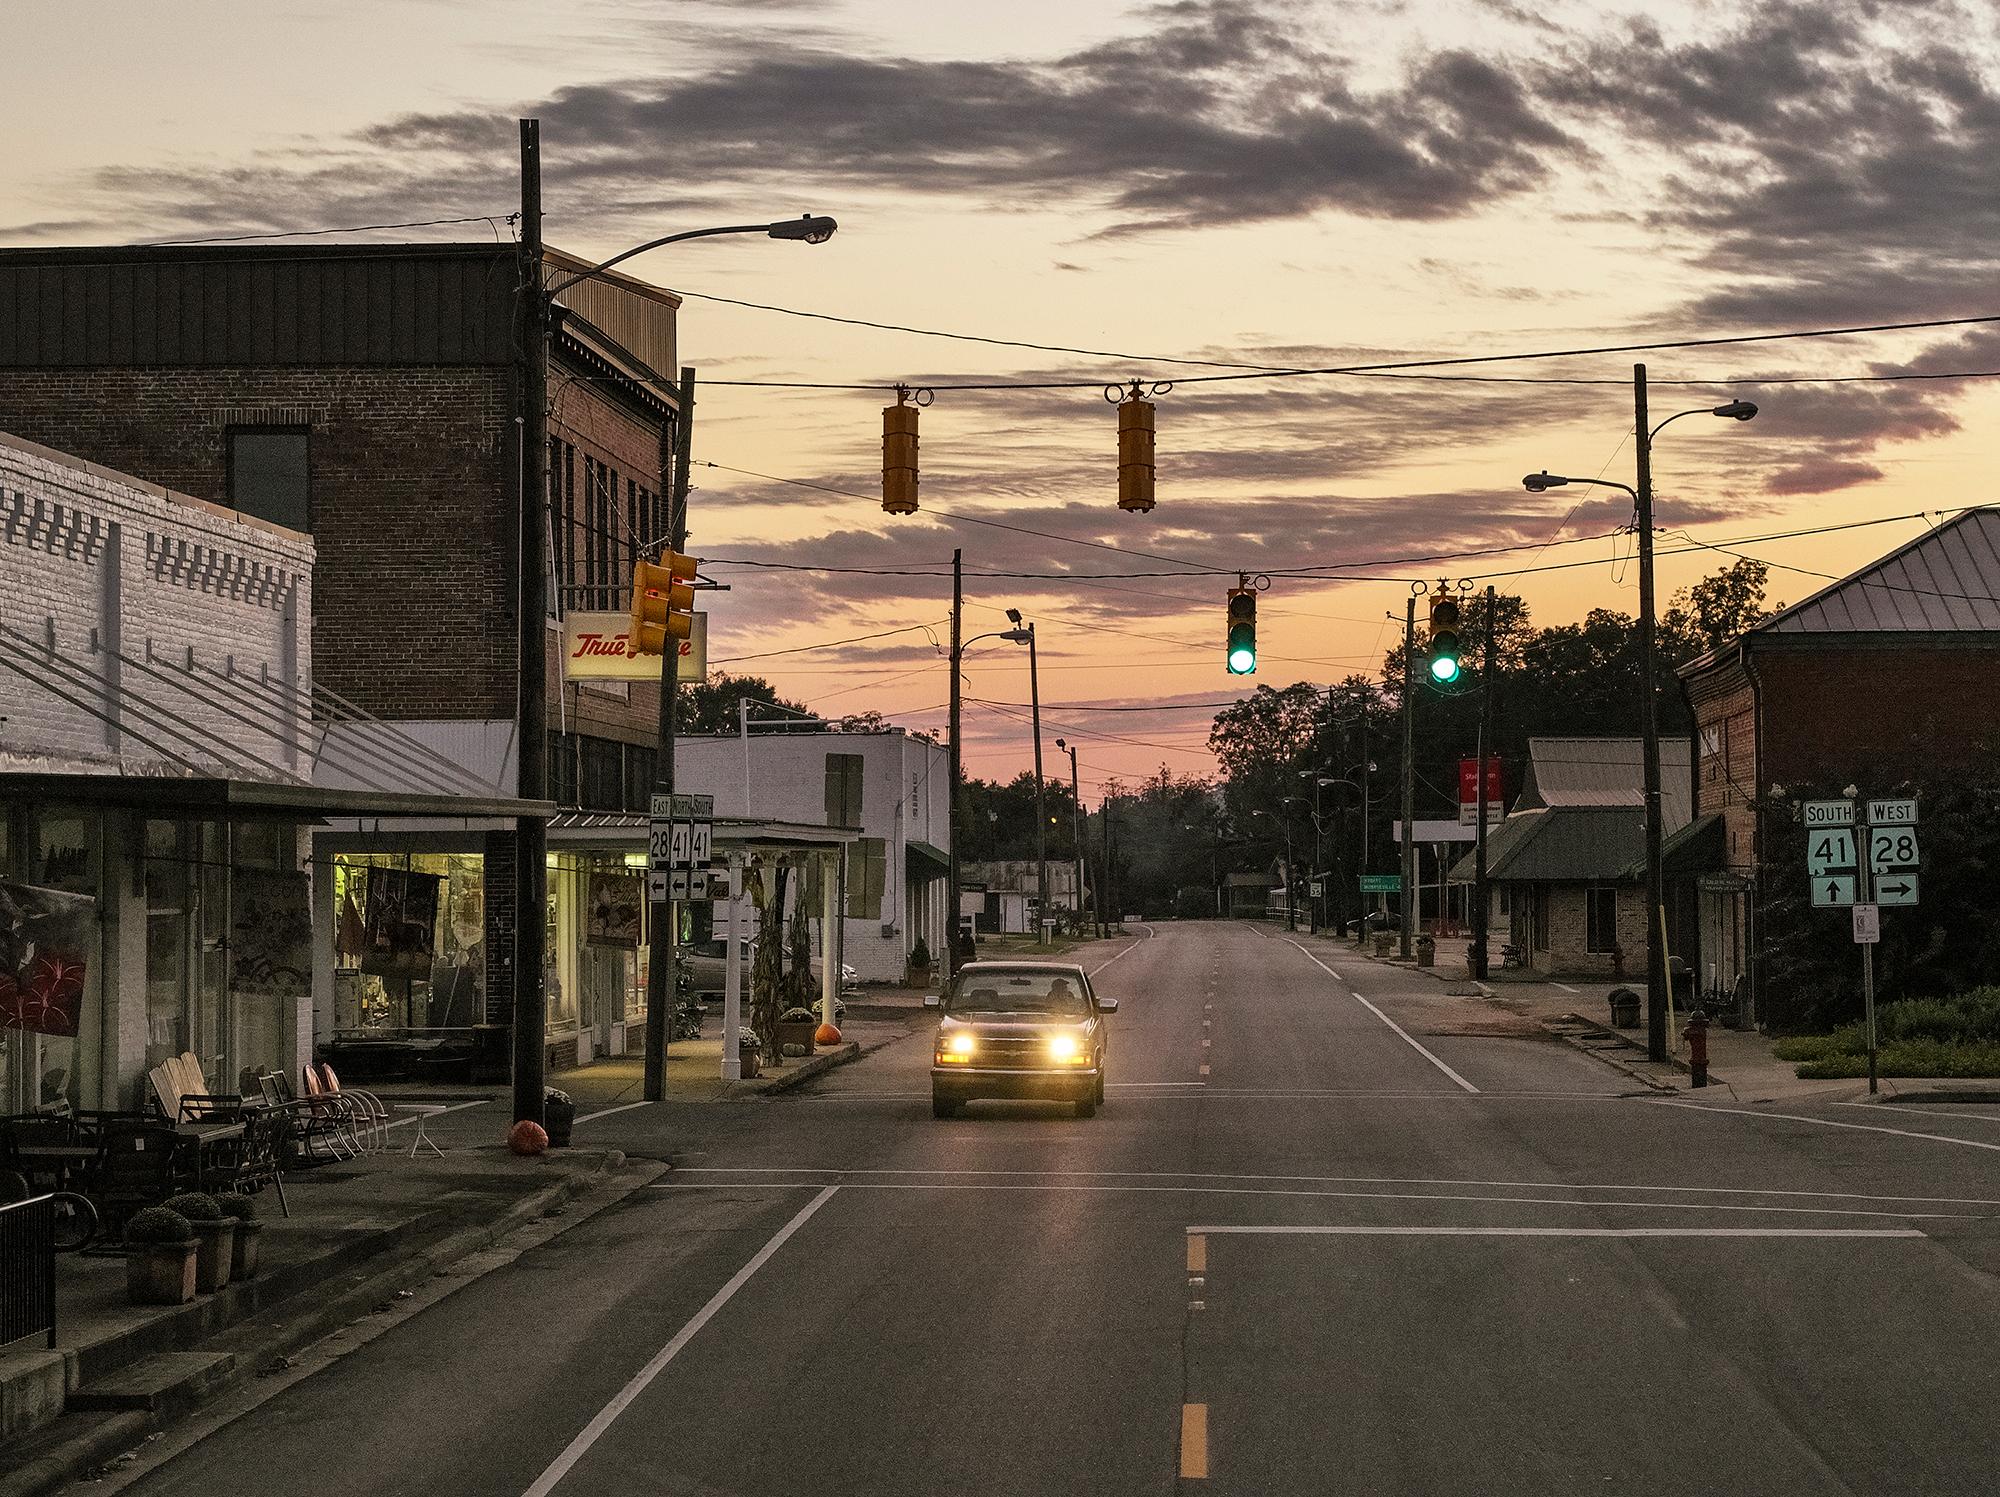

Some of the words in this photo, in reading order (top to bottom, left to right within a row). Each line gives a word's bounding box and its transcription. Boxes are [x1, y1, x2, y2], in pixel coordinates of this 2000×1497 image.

[572, 634, 626, 658] True
[653, 799, 670, 815] EAST
[673, 799, 692, 815] NORTH
[694, 799, 712, 815] SOUTH
[1807, 806, 1852, 821] SOUTH
[1874, 805, 1912, 820] WEST
[651, 831, 668, 858] 28
[673, 831, 687, 858] 41
[694, 831, 707, 858] 41
[1814, 837, 1846, 864] 41
[1876, 835, 1914, 863] 28
